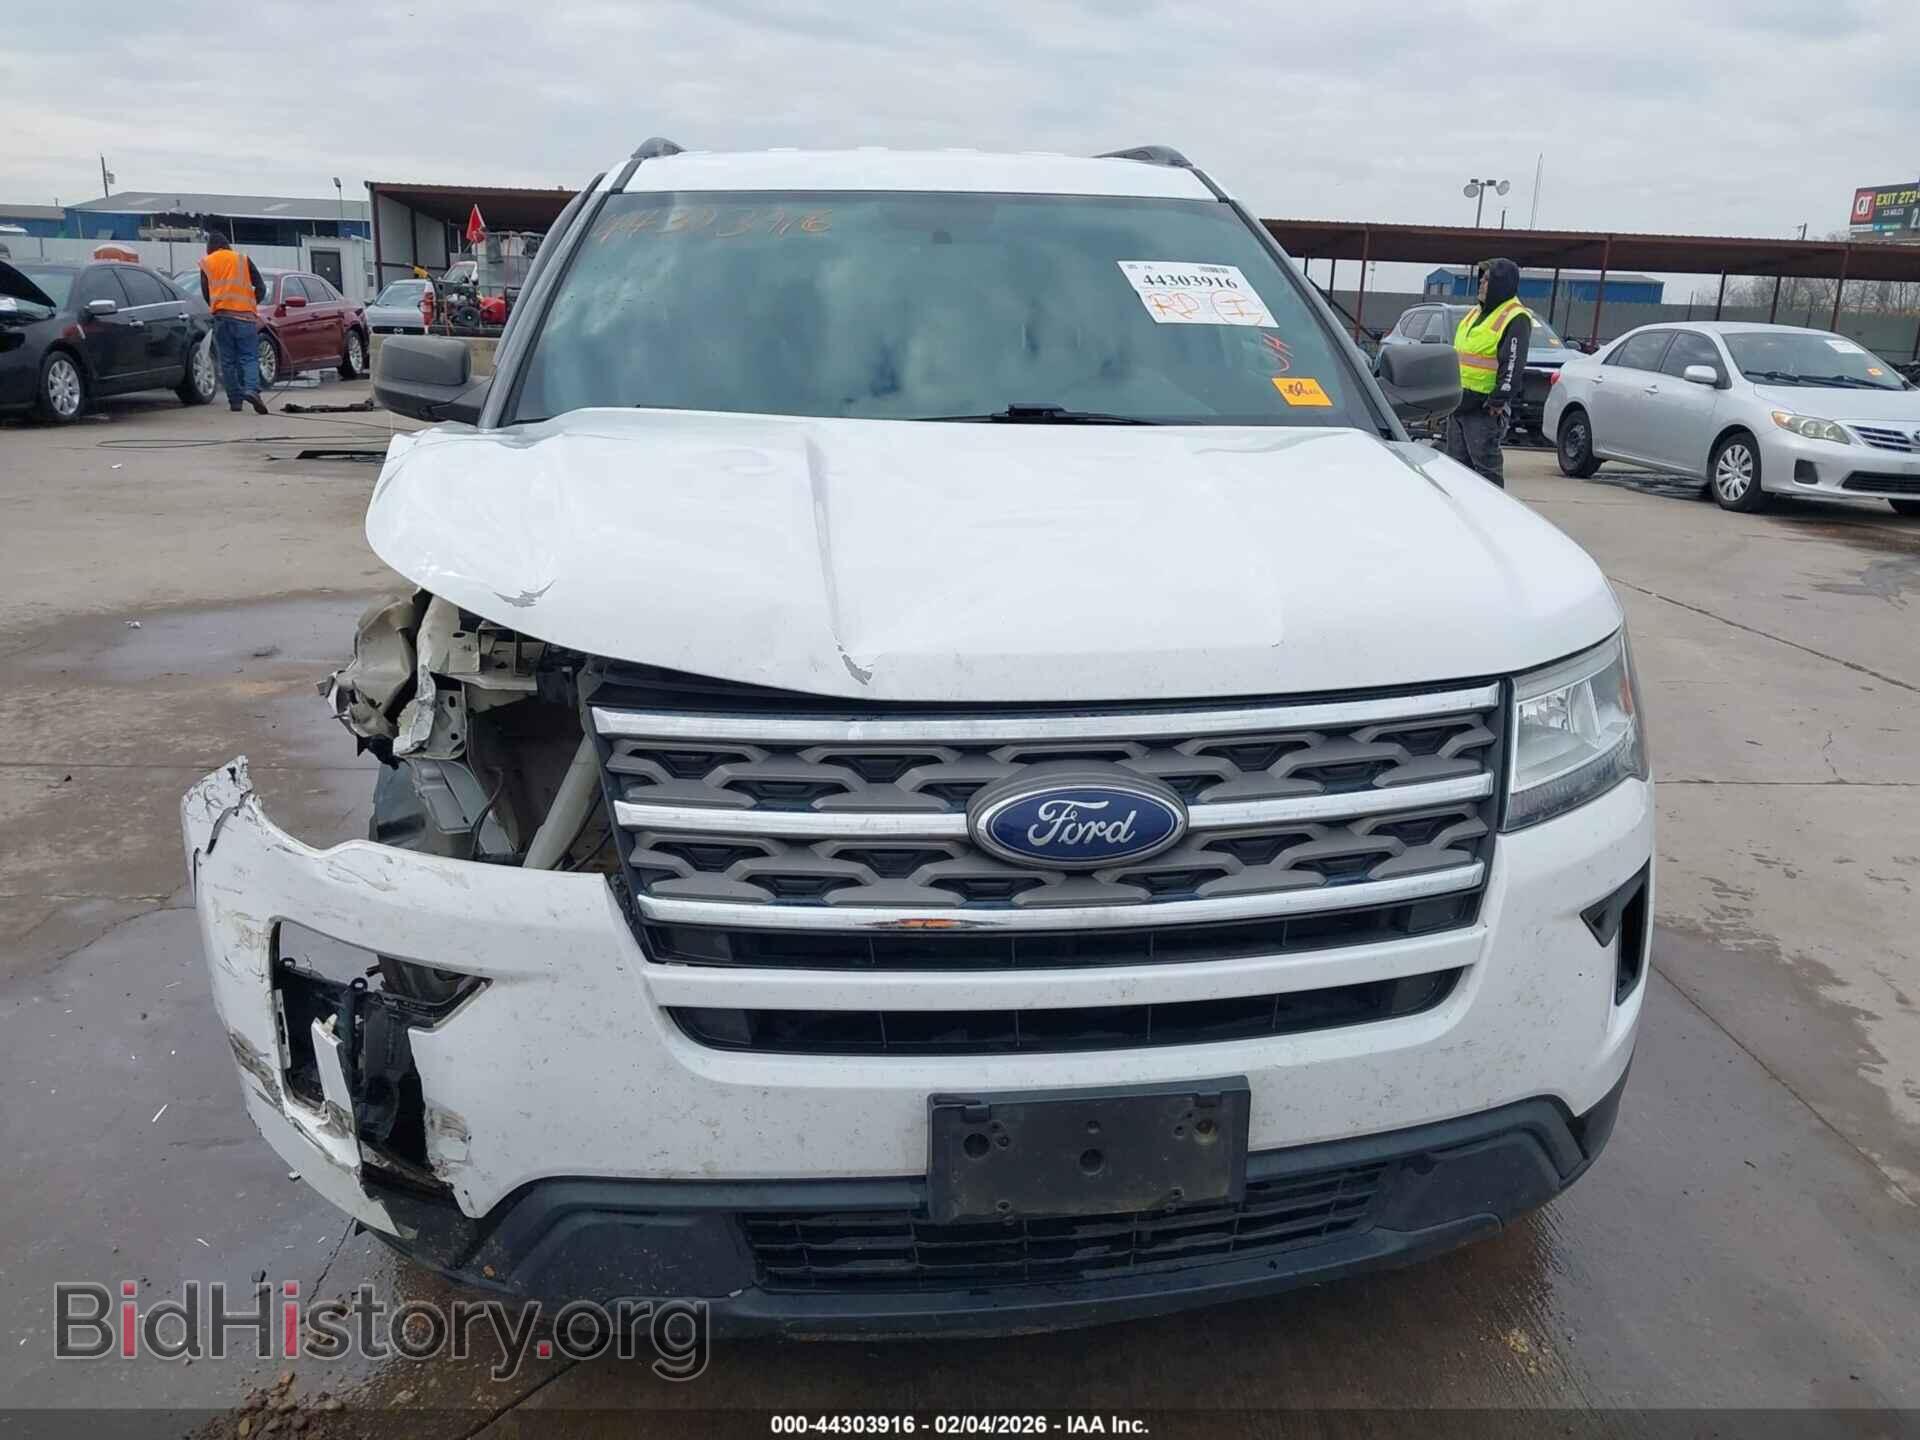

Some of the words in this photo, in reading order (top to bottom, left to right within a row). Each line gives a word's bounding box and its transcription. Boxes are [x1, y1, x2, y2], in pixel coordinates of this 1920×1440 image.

[1857, 196, 1872, 215] QT
[1876, 192, 1898, 206] EXIT
[1143, 274, 1238, 289] 44303916
[1027, 800, 1137, 847] Ford
